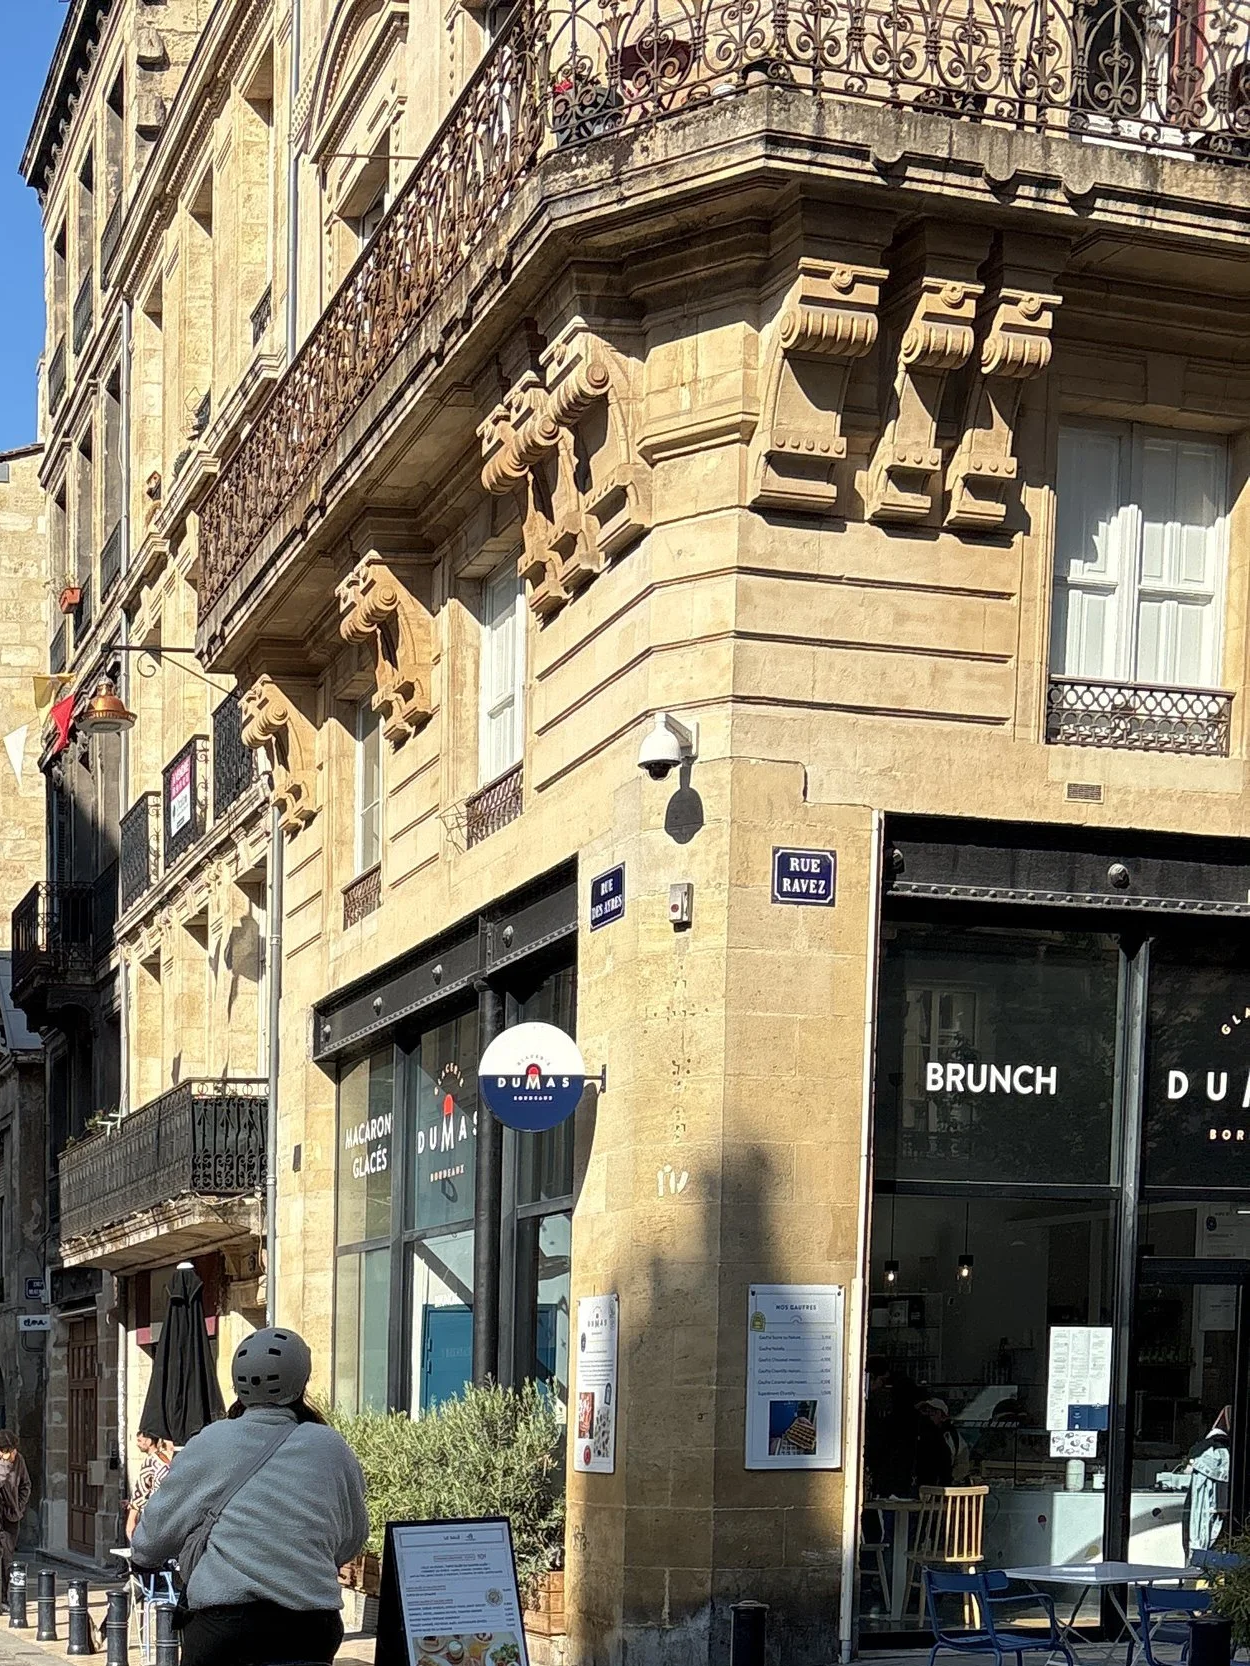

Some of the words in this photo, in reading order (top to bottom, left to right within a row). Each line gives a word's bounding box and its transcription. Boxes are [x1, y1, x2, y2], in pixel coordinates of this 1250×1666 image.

[789, 857, 821, 873] RUE
[782, 877, 827, 894] RAVEZ
[497, 1074, 570, 1090] DUMAS
[926, 1062, 1058, 1096] BRUNCH
[1167, 1069, 1250, 1109] DU
[344, 1111, 395, 1151] MACARON
[352, 1143, 388, 1179] GLACÉS
